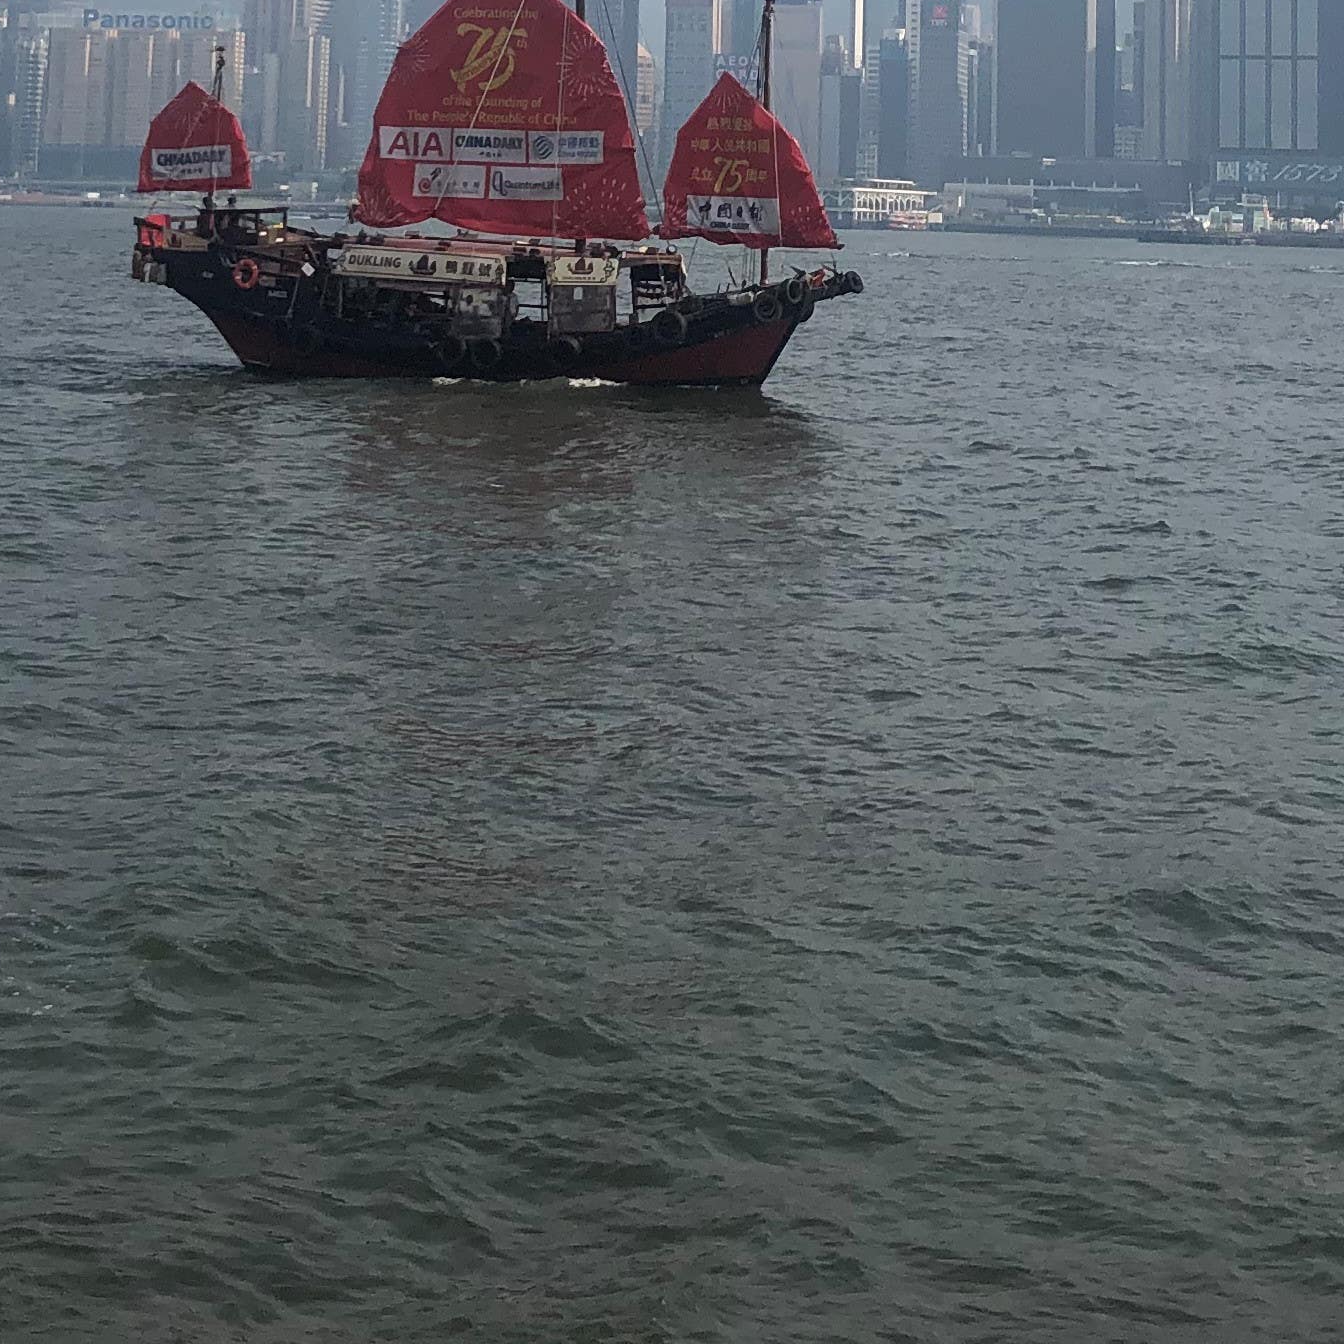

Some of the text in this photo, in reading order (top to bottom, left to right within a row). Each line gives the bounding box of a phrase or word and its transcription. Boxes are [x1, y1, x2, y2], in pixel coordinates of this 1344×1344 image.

[83, 8, 214, 29] Panasonic
[442, 96, 456, 106] of
[531, 97, 544, 107] of
[407, 110, 429, 122] The
[478, 111, 525, 124] Republic
[528, 113, 541, 124] of
[544, 114, 577, 125] China
[388, 131, 443, 156] AIA
[348, 255, 402, 269] DUKLING
